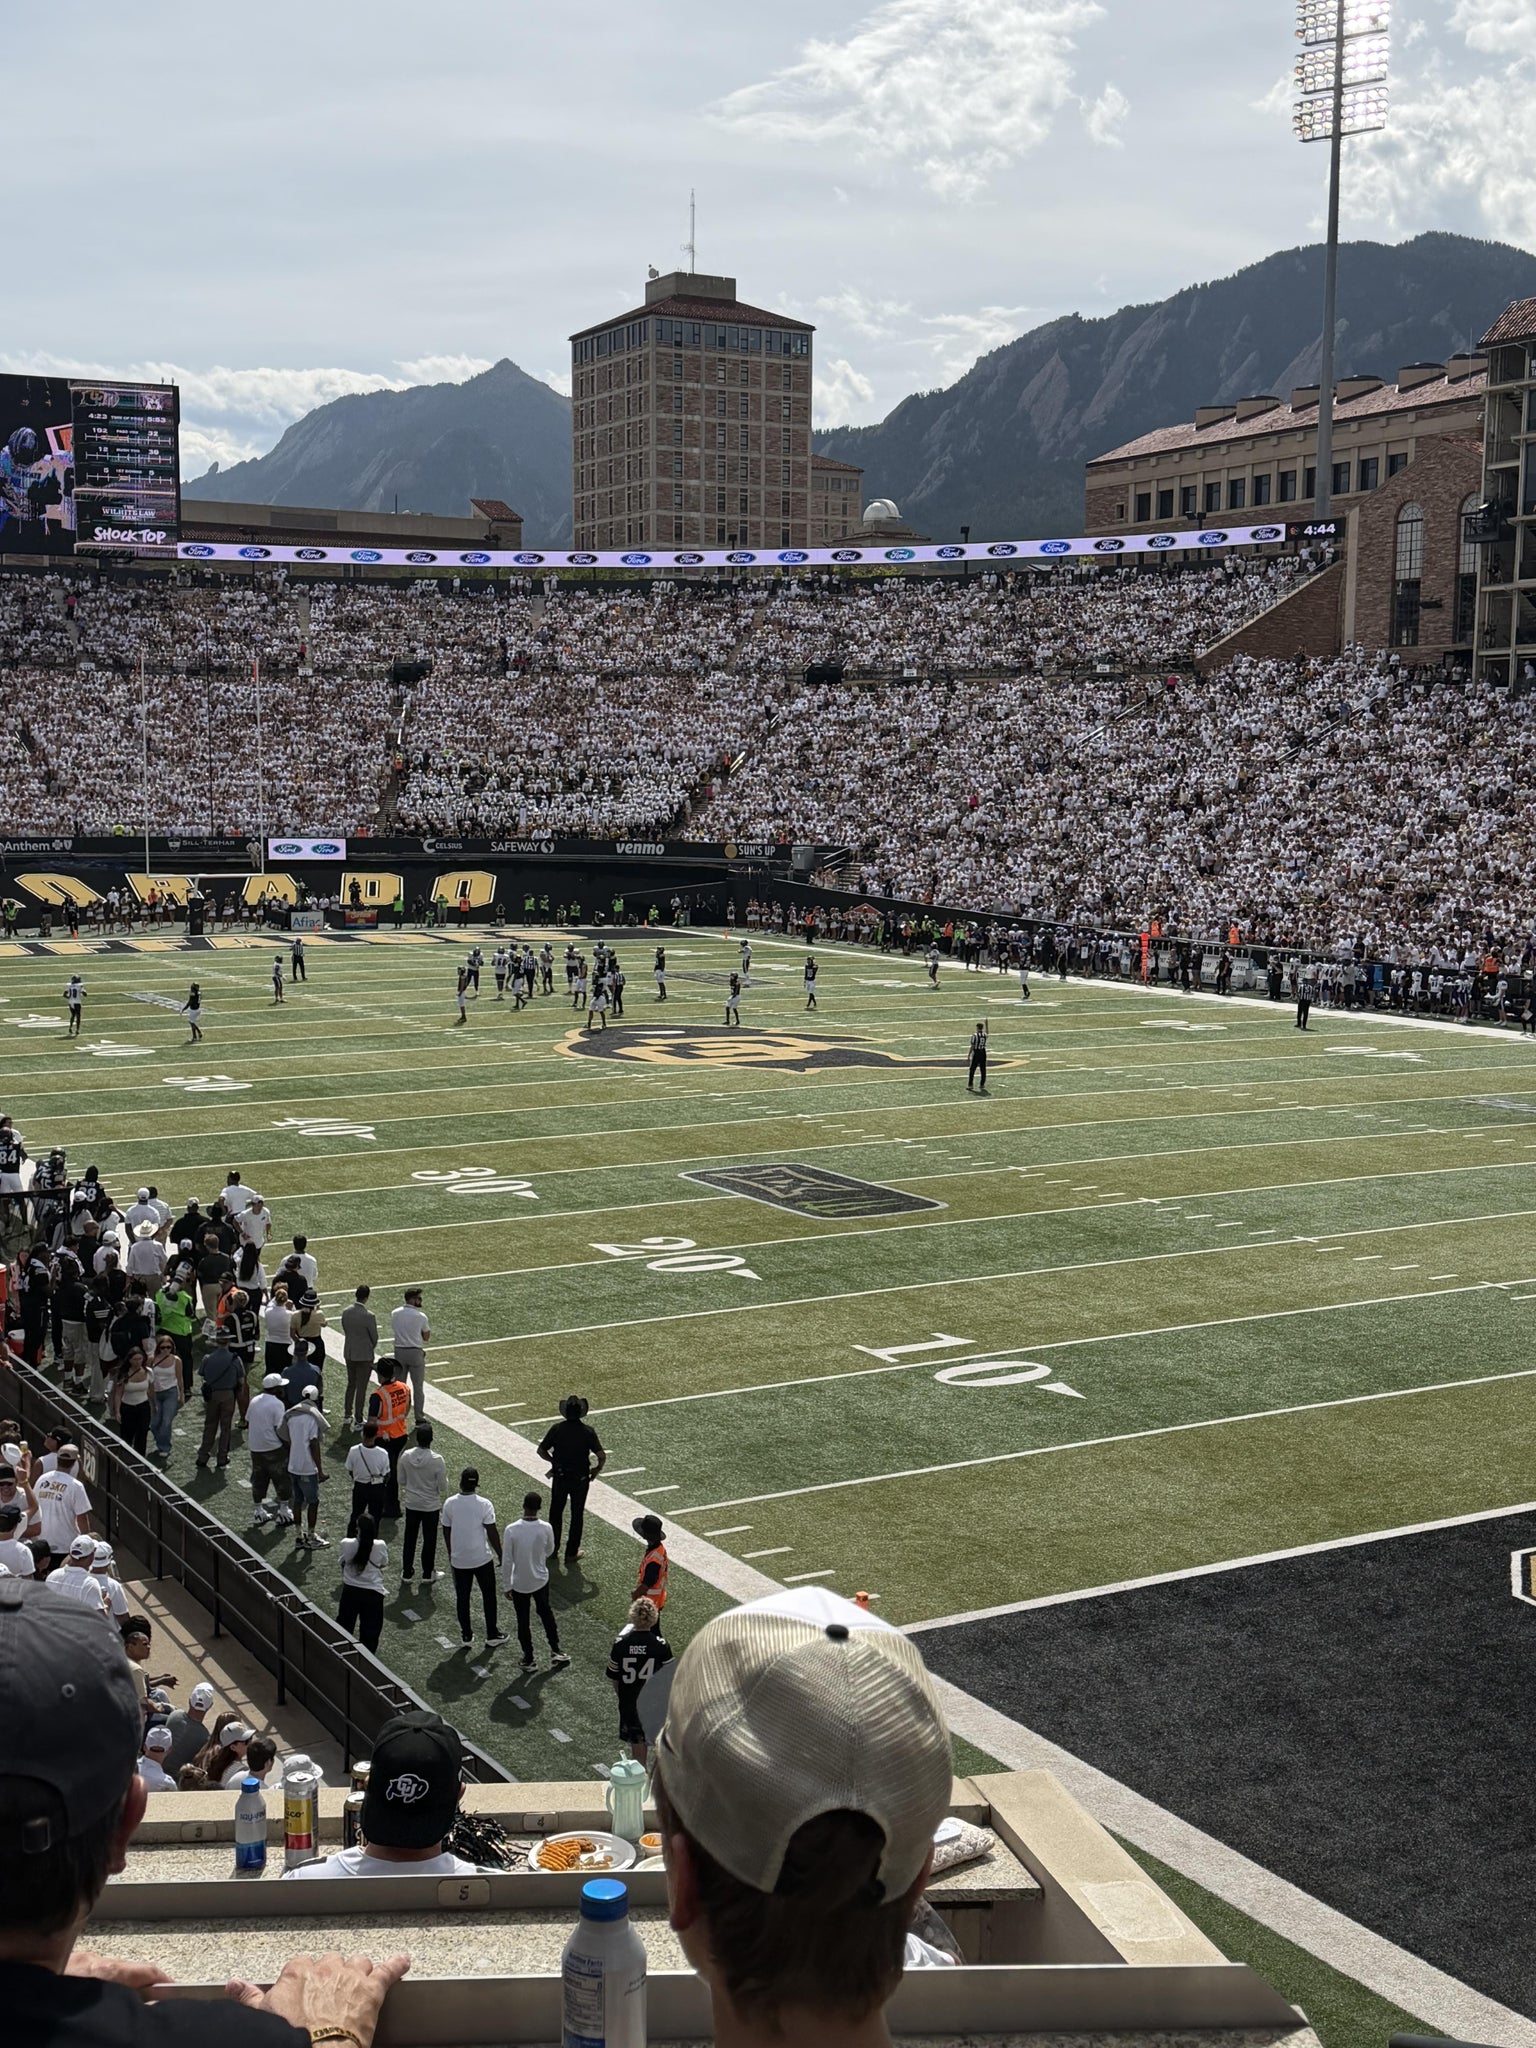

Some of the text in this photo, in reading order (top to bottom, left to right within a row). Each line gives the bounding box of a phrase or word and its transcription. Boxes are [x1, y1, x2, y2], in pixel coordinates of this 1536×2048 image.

[88, 412, 108, 420] 4:23
[139, 509, 157, 518] LAW
[1255, 529, 1278, 539] Ford
[1303, 523, 1336, 536] 4:44
[1151, 536, 1173, 547] Ford
[1202, 533, 1225, 544] Ford
[991, 545, 1014, 555] Ford
[1043, 542, 1068, 553] Ford
[1098, 540, 1122, 550] Ford
[186, 545, 212, 556] Ford
[243, 548, 268, 558] Ford
[298, 550, 324, 560] Ford
[888, 549, 912, 560] Ford
[940, 547, 962, 558] Ford
[354, 551, 379, 561] Ford
[409, 552, 434, 562] Ford
[464, 553, 488, 563] Ford
[518, 554, 542, 563] Ford
[571, 554, 595, 564] Ford
[624, 554, 648, 564] Ford
[678, 554, 702, 563] Ford
[729, 553, 753, 562] Ford
[781, 552, 806, 562] Ford
[836, 551, 858, 561] Ford
[4, 840, 50, 850] Anthem
[277, 844, 300, 854] Ford
[315, 844, 337, 854] Ford
[435, 841, 463, 850] CELSIUS
[490, 841, 539, 852] SAFEWAY
[615, 842, 665, 855] venmo
[738, 844, 776, 856] SUN'S UP
[0, 871, 497, 909] ORADO
[271, 1117, 376, 1136] 40
[411, 1166, 534, 1194] 30
[588, 1236, 747, 1273] 20
[850, 1332, 1053, 1388] 10
[629, 1645, 647, 1655] ROSE
[622, 1657, 655, 1684] 54
[458, 1885, 469, 1900] 5
